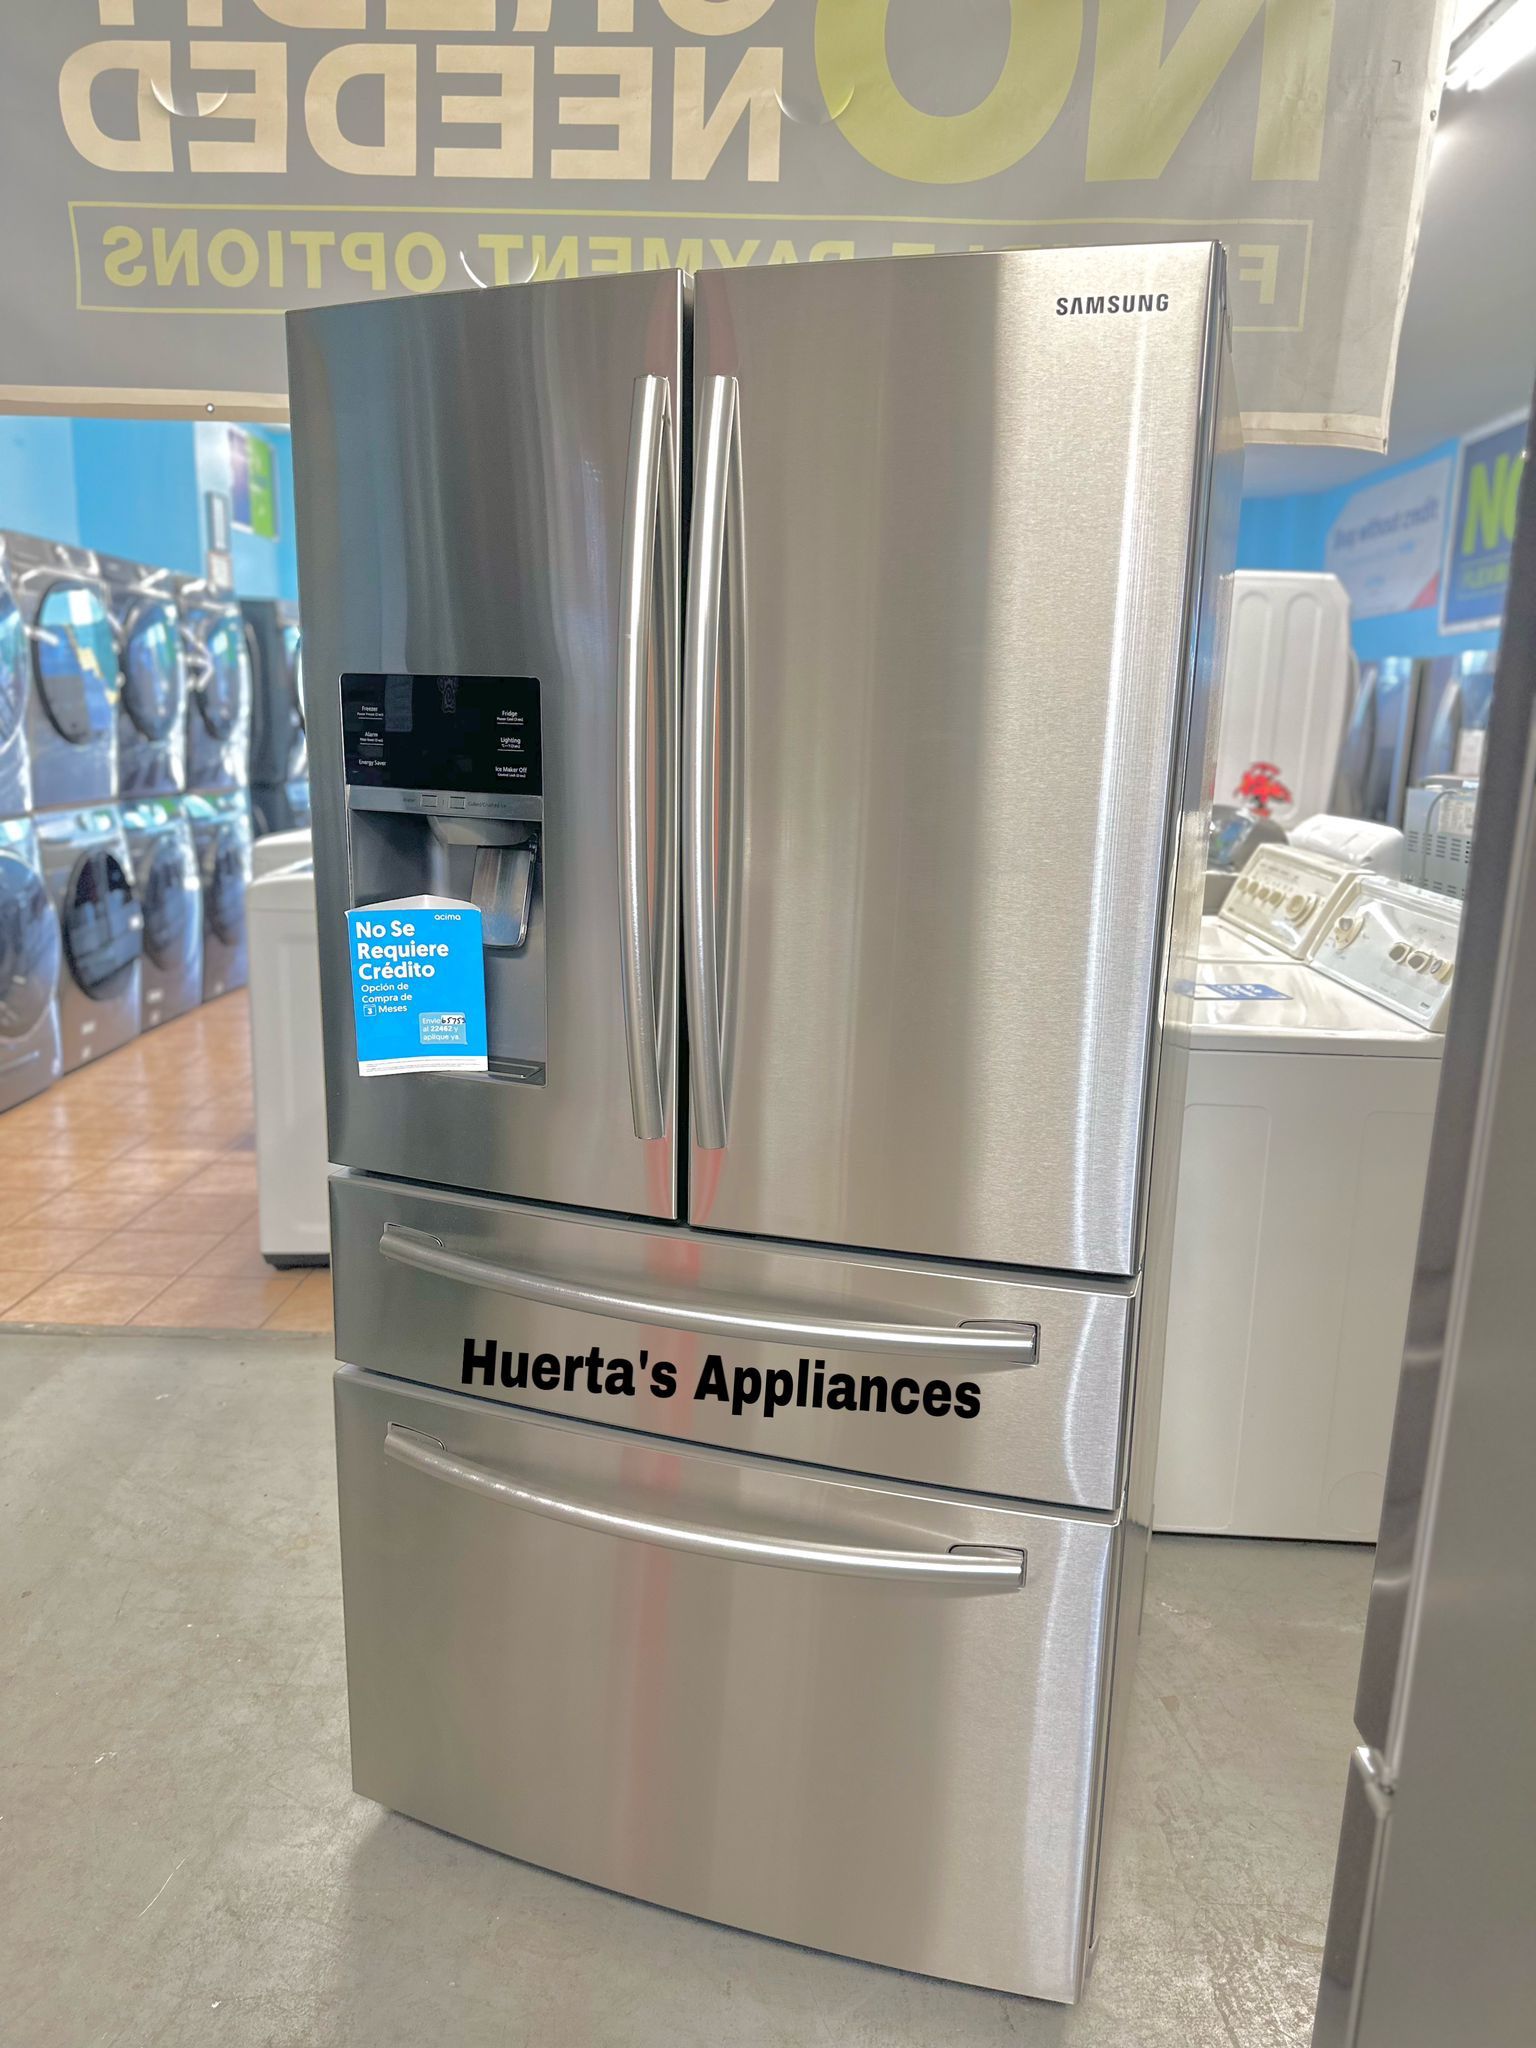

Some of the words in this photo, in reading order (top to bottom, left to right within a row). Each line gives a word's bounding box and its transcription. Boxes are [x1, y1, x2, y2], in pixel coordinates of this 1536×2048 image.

[1056, 293, 1169, 316] SAMSUNG
[500, 736, 521, 744] Lighting
[358, 759, 374, 767] Energy
[434, 913, 461, 921] acima
[356, 921, 386, 939] No
[391, 920, 416, 937] Se
[357, 940, 449, 962] Requiere
[359, 961, 435, 980] Crédito
[361, 983, 394, 993] Opción
[397, 982, 409, 991] de
[361, 994, 399, 1004] Compra
[401, 993, 413, 1001] de
[378, 1005, 408, 1013] Meses
